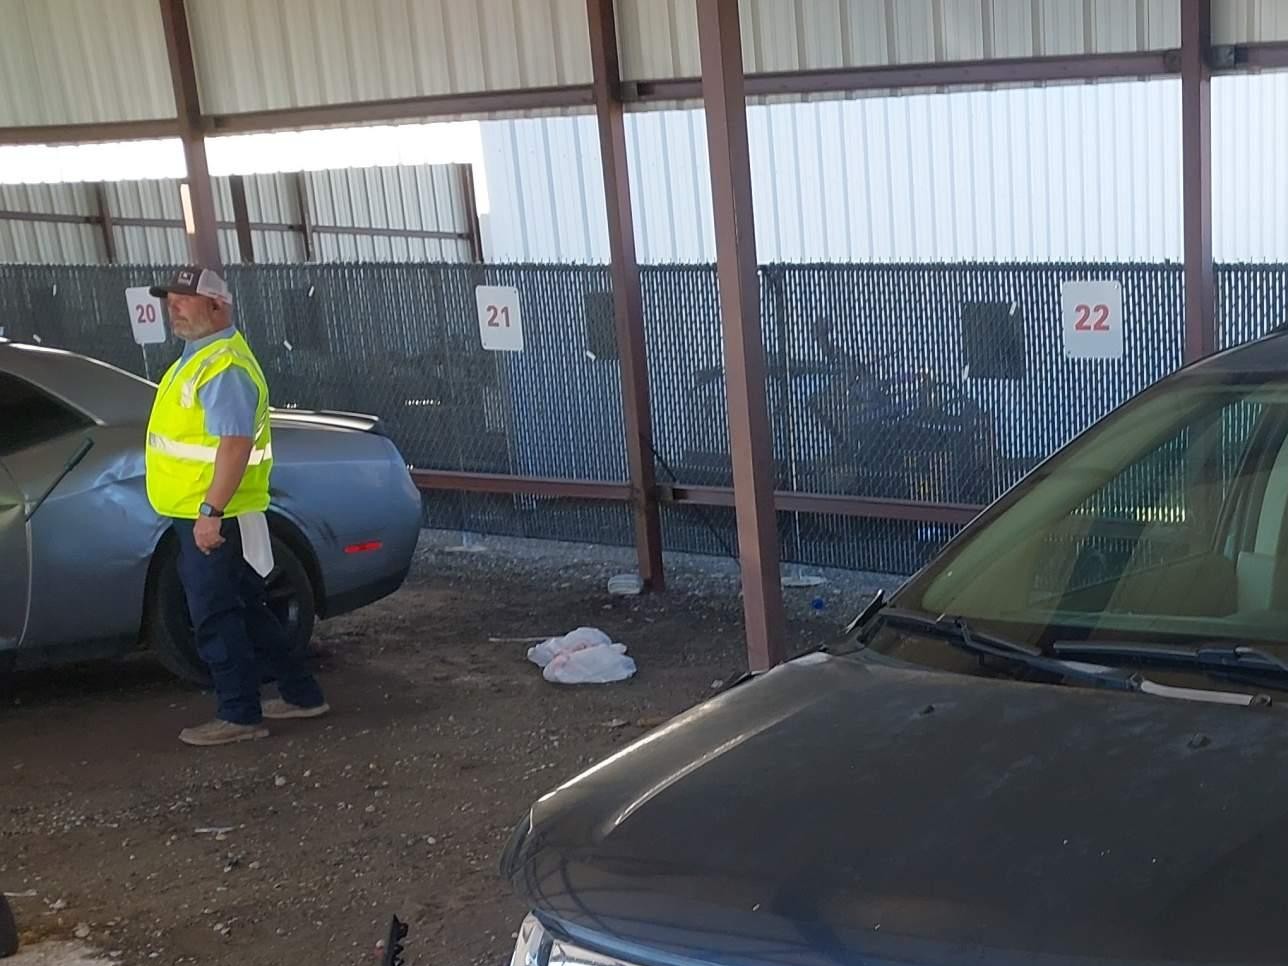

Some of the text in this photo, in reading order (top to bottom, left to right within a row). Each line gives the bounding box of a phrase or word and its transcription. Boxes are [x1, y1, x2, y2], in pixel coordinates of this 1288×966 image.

[136, 304, 156, 323] 20
[486, 305, 510, 328] 21
[1075, 304, 1110, 331] 22
